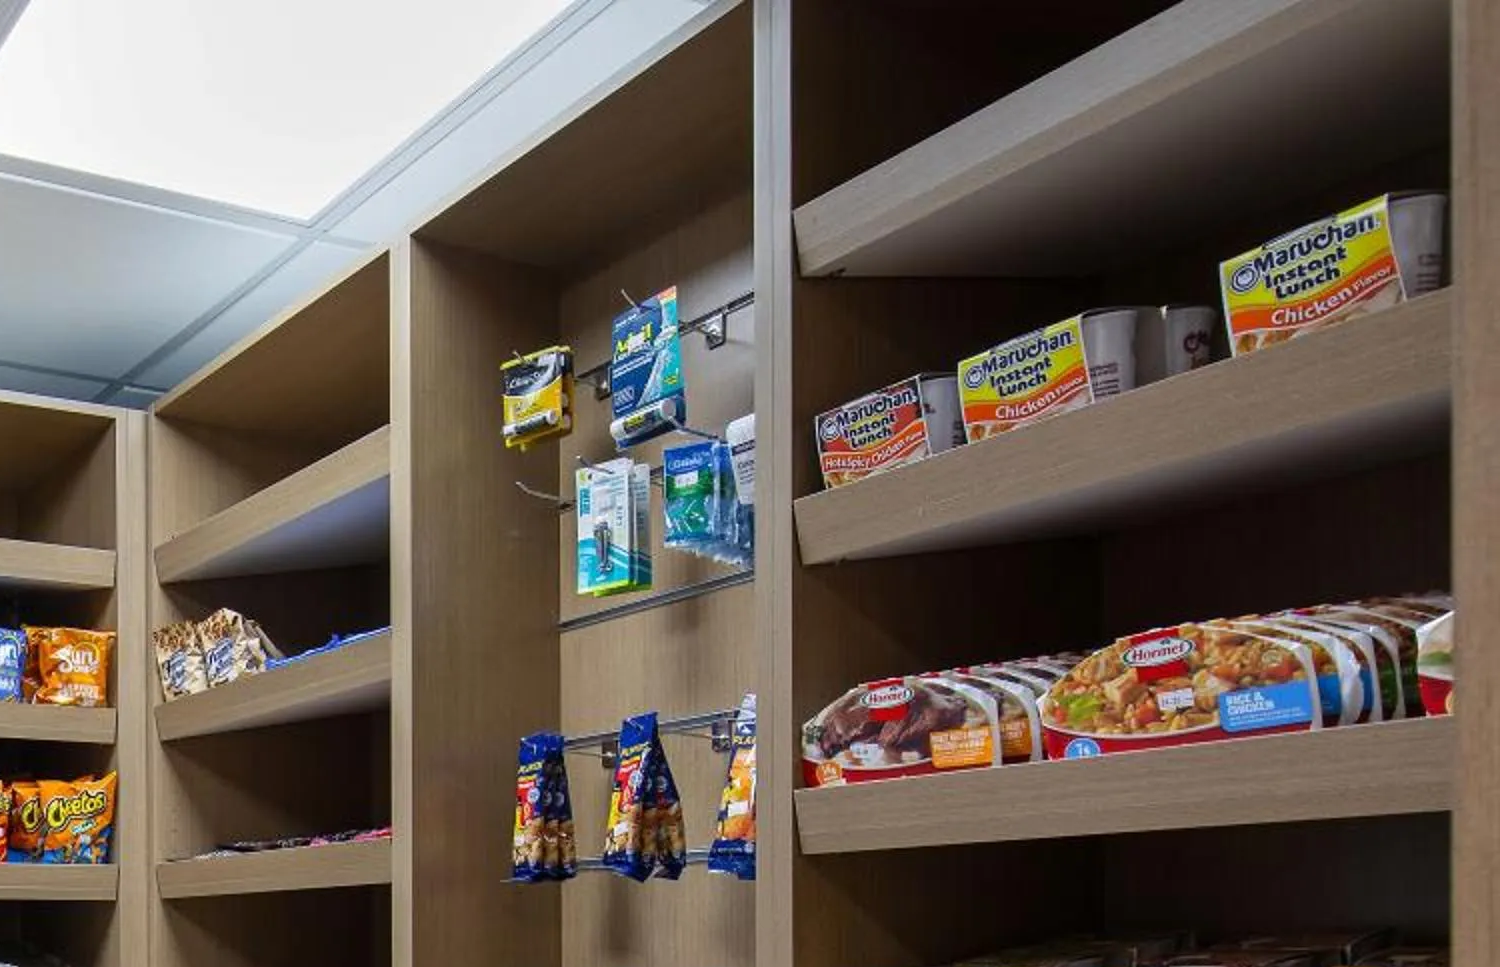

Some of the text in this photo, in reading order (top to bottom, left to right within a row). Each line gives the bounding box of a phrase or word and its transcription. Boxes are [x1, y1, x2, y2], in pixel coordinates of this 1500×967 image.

[1253, 213, 1377, 273] Maruchan
[1264, 247, 1347, 289] Instant
[1275, 267, 1341, 299] Lunch
[1271, 286, 1353, 325] Chicken
[981, 330, 1073, 373] Maruchan
[989, 356, 1052, 387] Instant
[998, 373, 1047, 397] Lunch
[836, 389, 913, 426] Maruchan
[995, 390, 1056, 419] Chicken
[843, 413, 895, 438] Instant
[851, 427, 892, 449] Lunch
[1131, 643, 1187, 662] Hormel
[47, 792, 106, 829] Cheetos
